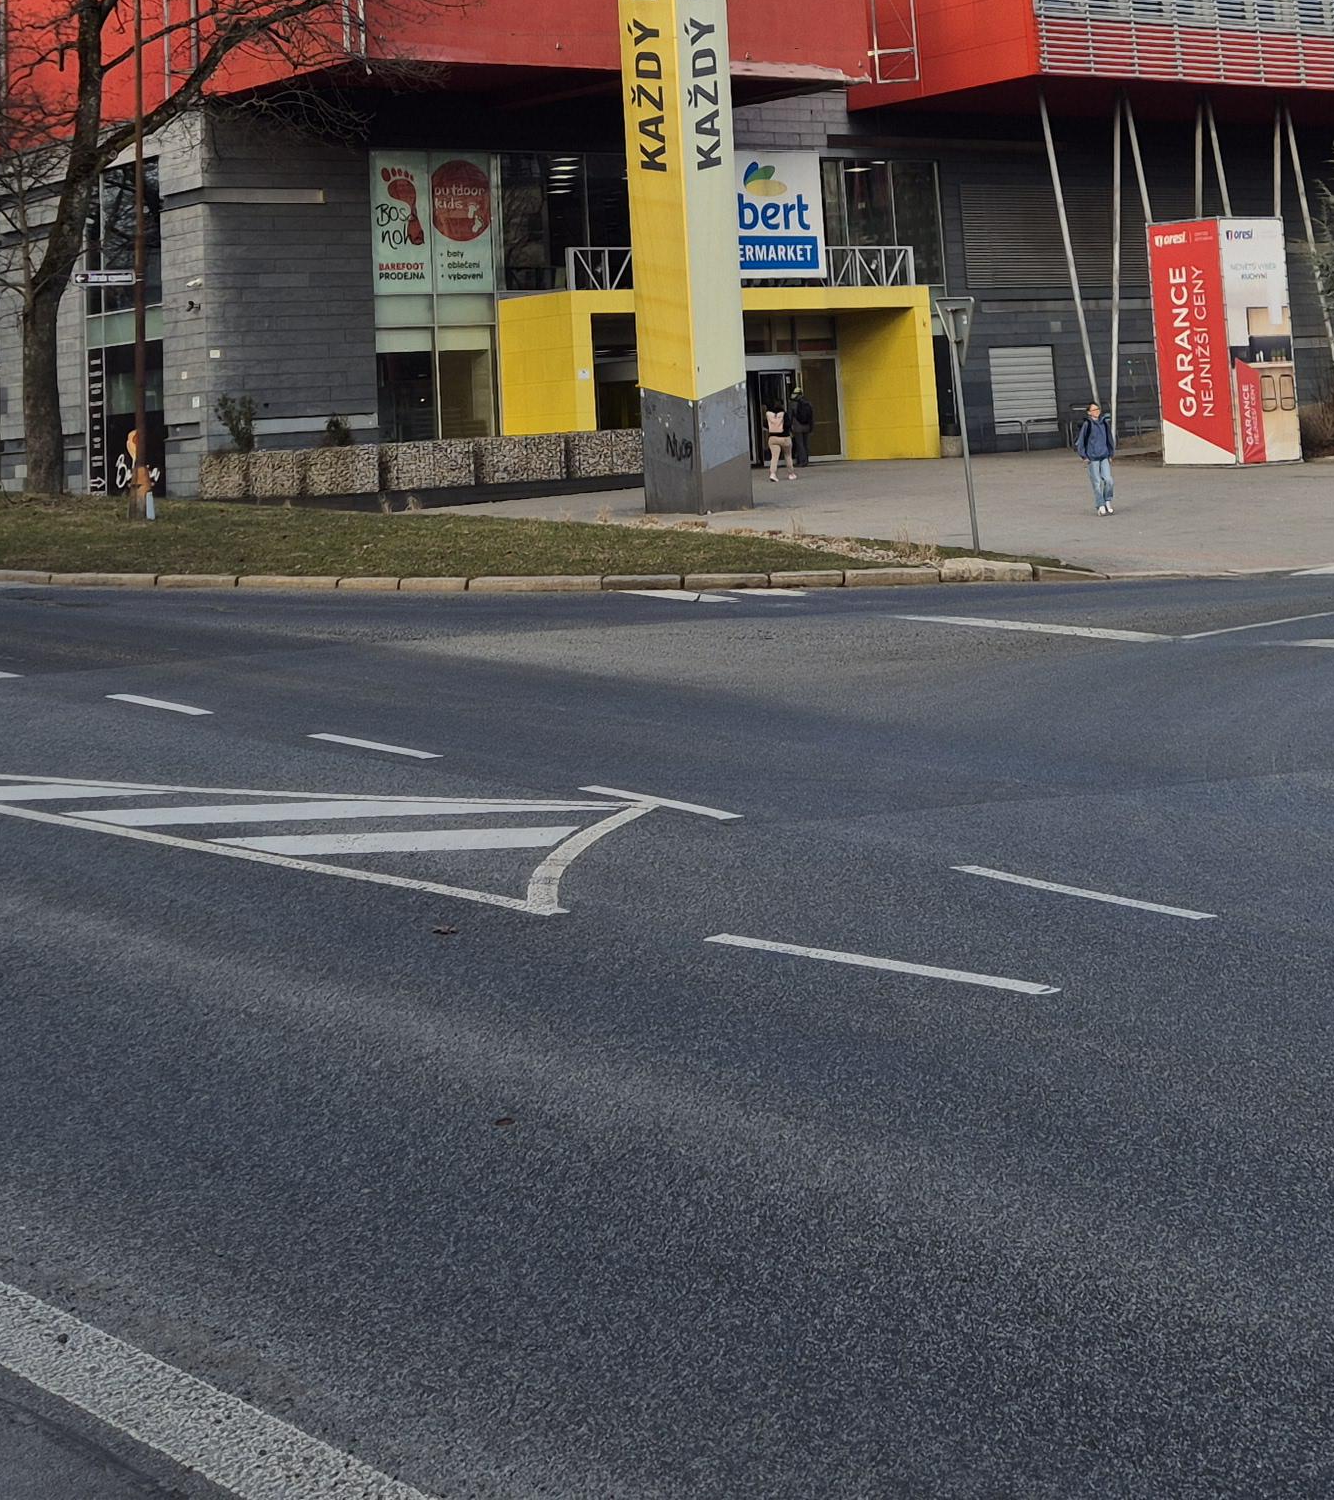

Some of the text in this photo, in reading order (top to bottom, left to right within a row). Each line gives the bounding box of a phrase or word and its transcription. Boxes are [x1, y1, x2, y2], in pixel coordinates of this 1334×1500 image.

[627, 18, 667, 172] KAŽDÝ
[683, 18, 722, 171] KAŽDÝ
[434, 184, 485, 196] outdoor
[434, 198, 464, 210] kids
[737, 192, 811, 231] bert
[379, 263, 425, 271] BAREFOOT
[379, 272, 425, 281] PRODEJNA
[1169, 266, 1197, 418] GARANCE
[1191, 266, 1215, 417] NEJNIŽŠÍ CENY
[1242, 384, 1255, 446] GARANCE
